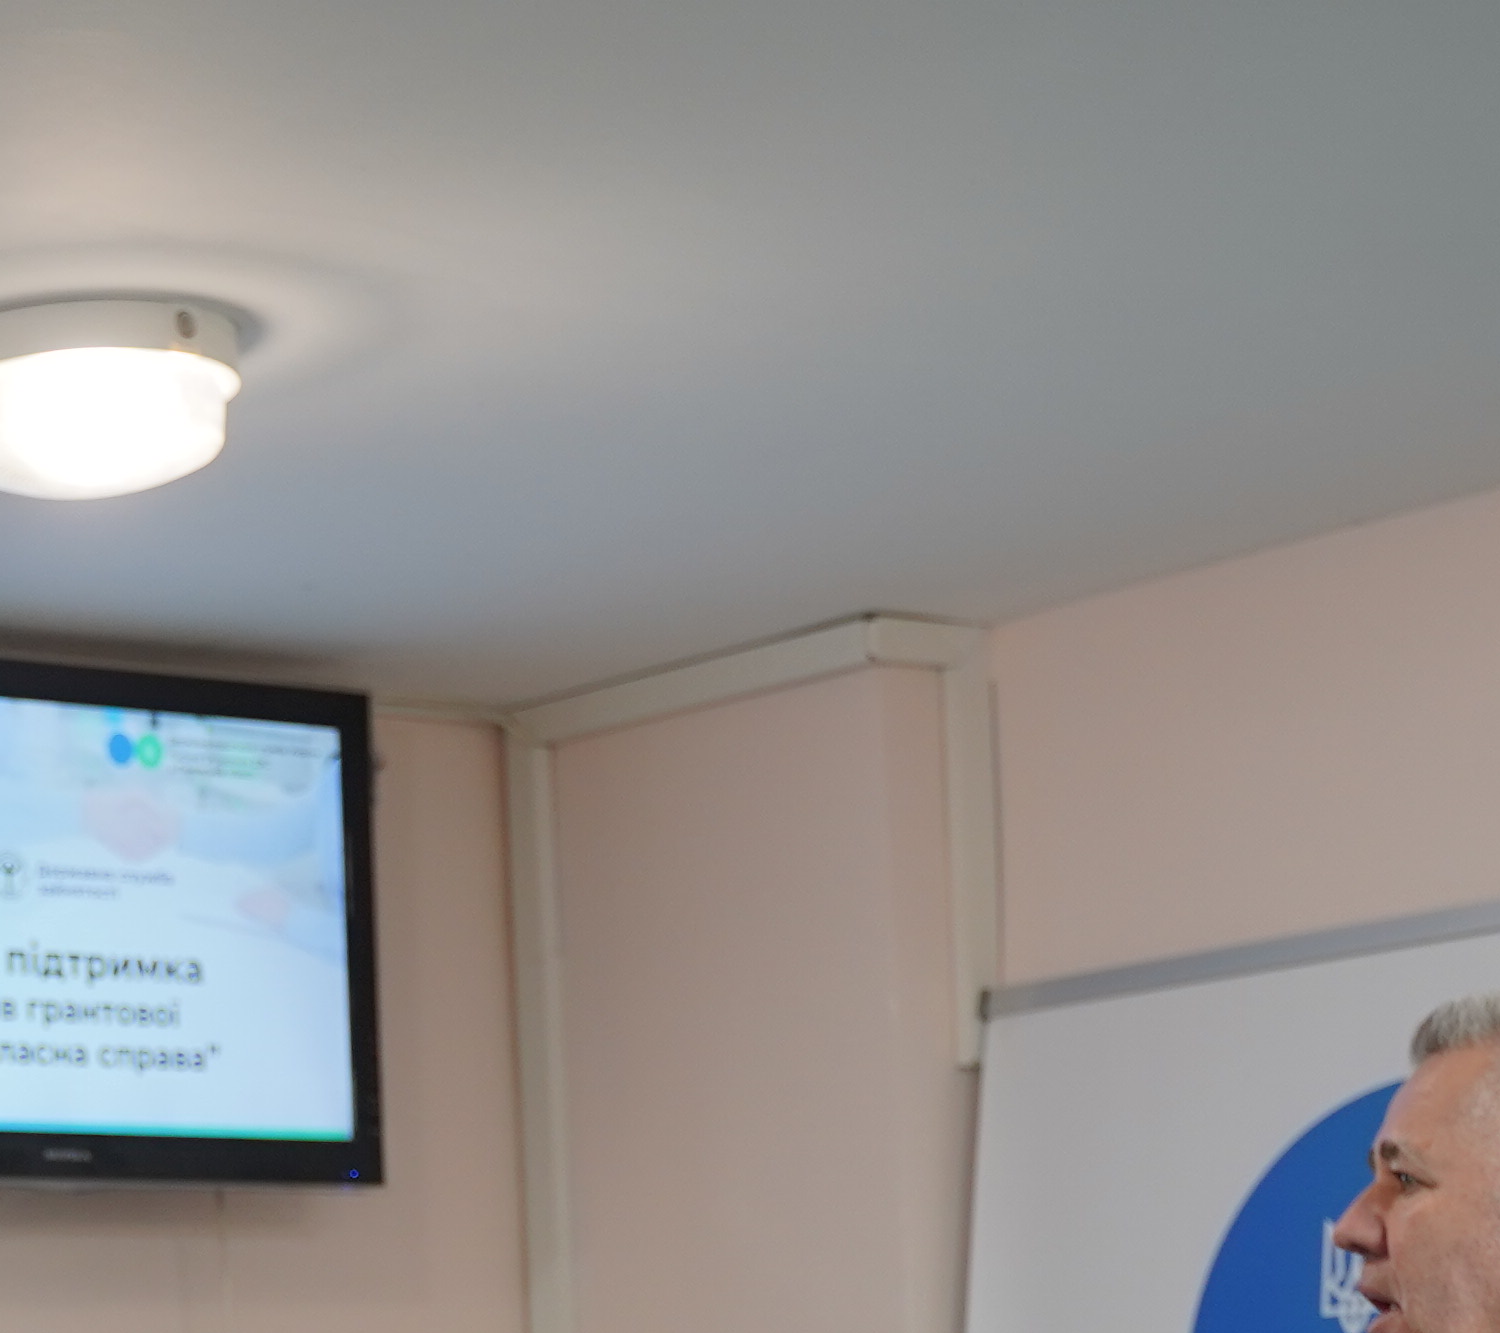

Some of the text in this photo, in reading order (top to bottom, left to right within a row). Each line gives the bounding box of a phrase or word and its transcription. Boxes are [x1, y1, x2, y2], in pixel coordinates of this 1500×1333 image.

[5, 942, 205, 986] підтримка
[26, 998, 181, 1028] грантової
[100, 1045, 222, 1075] справа"
